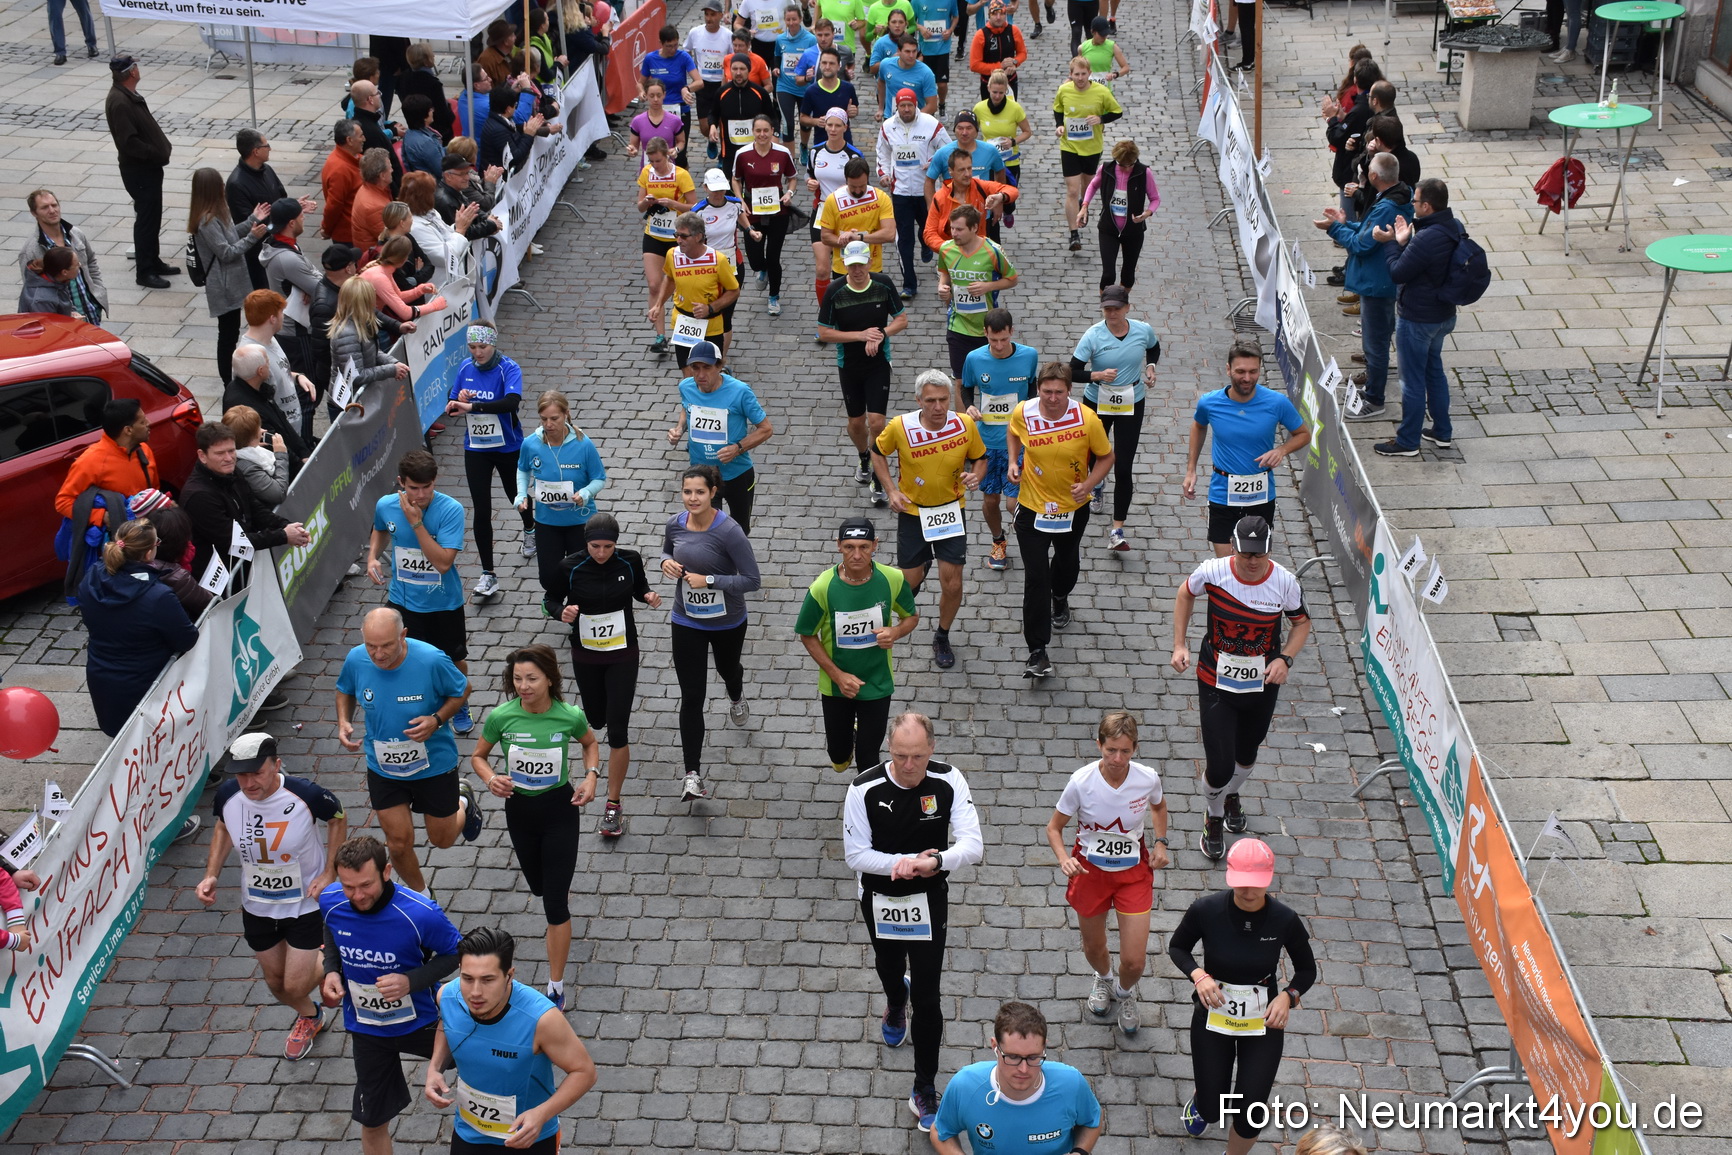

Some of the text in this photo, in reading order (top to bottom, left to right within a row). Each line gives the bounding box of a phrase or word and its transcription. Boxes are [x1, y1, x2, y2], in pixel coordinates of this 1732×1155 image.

[119, 0, 268, 18] Vernetzt, um frei zu sein.
[734, 127, 749, 136] 290
[1069, 124, 1089, 132] 2146
[896, 151, 916, 160] 2244
[758, 195, 773, 205] 165
[839, 203, 880, 220] MAX BÖGL
[652, 217, 672, 228] 2617
[675, 268, 718, 279] MAX BÖGL
[678, 324, 702, 338] 2630
[1109, 394, 1123, 405] 46
[988, 403, 1009, 413] 208
[471, 423, 496, 436] 2327
[695, 417, 721, 431] 2773
[1028, 429, 1086, 448] MAX BÖGL
[911, 436, 969, 459] MAX BÖGL
[1233, 479, 1264, 494] 2218
[540, 491, 568, 503] 2004
[926, 511, 956, 527] 2628
[402, 558, 435, 573] 2442
[208, 564, 224, 589] swn
[686, 591, 717, 605] 2087
[590, 624, 615, 638] 127
[842, 619, 875, 636] 2571
[1223, 665, 1258, 680] 2790
[383, 749, 420, 764] 2522
[516, 760, 554, 775] 2023
[10, 832, 36, 859] swn
[1096, 839, 1133, 856] 2495
[252, 874, 293, 889] 2420
[881, 907, 922, 923] 2013
[339, 945, 396, 965] SYSCAD
[77, 922, 126, 1006] Service-Line:
[1227, 1000, 1247, 1017] 31
[1225, 1018, 1249, 1029] Stefanie
[491, 1048, 518, 1060] THULE
[468, 1100, 501, 1122] 272
[1028, 1130, 1063, 1142] BOCK
